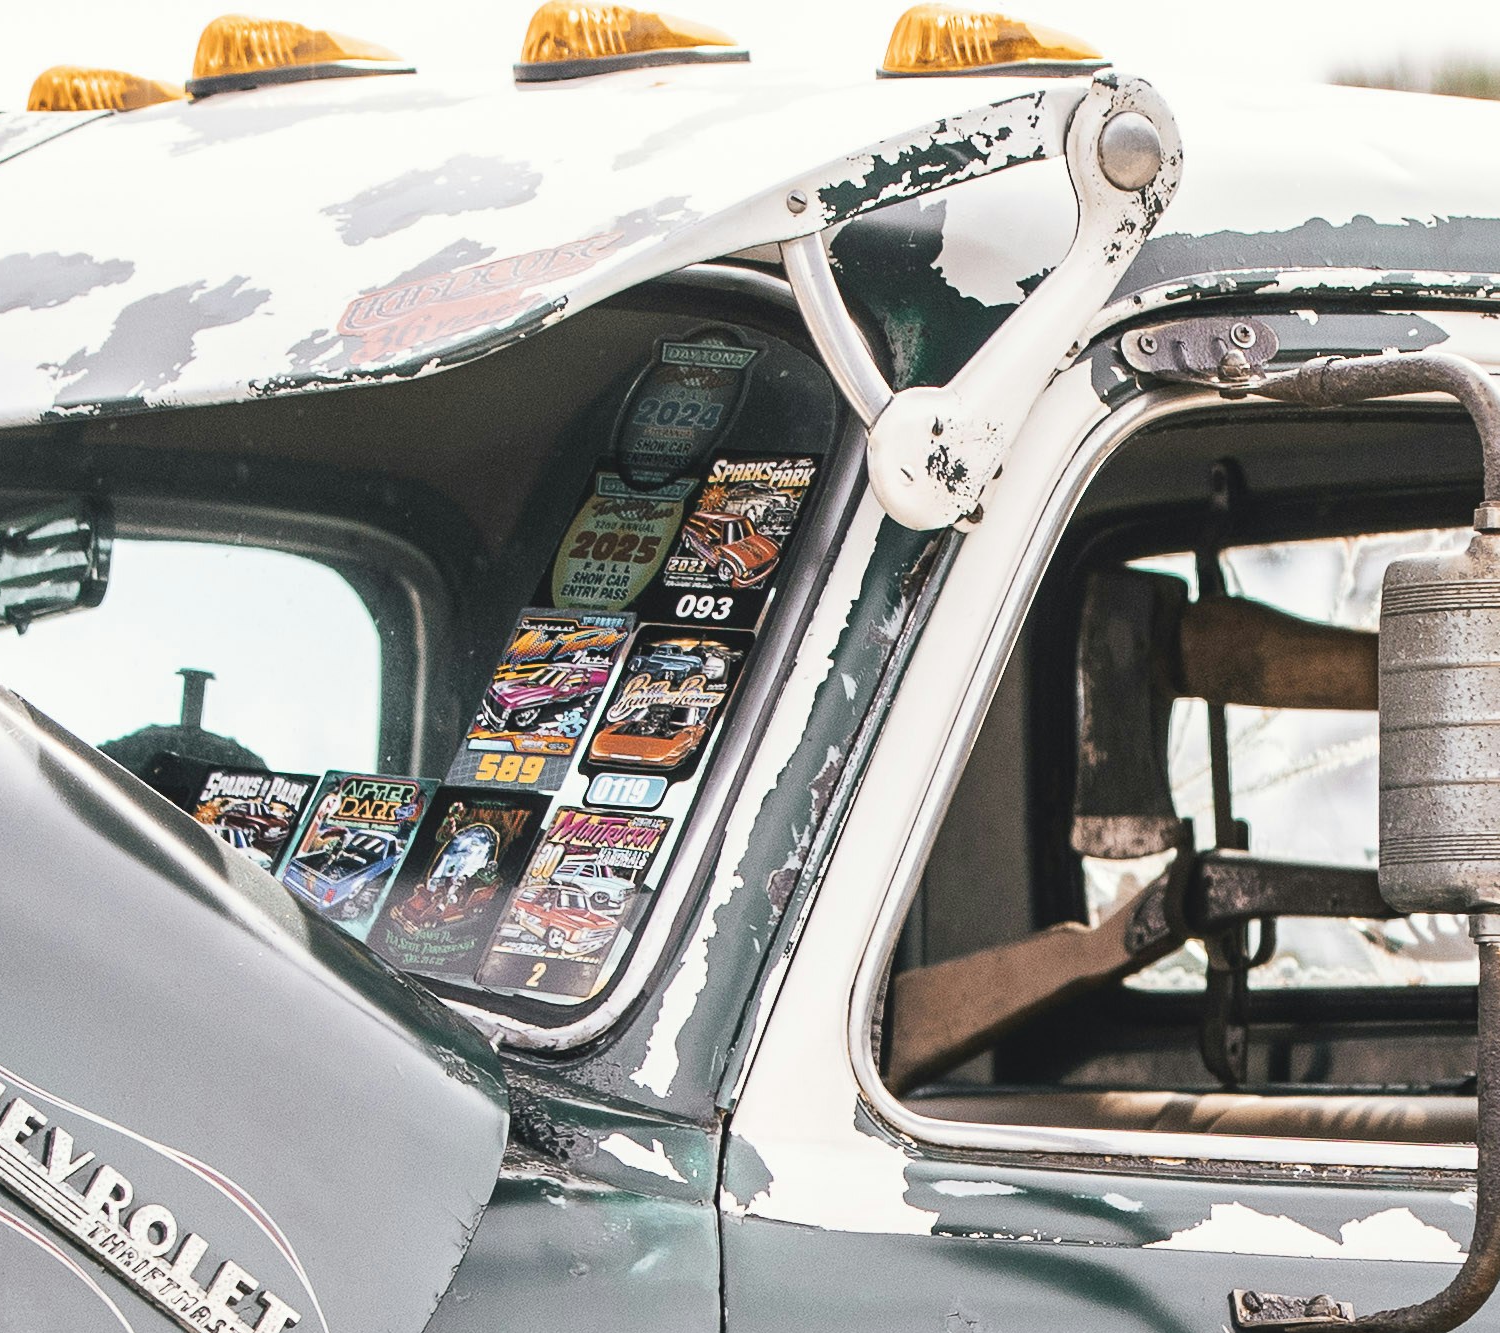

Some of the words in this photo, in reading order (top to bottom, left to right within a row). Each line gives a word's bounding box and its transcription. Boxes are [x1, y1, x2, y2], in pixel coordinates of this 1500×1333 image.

[668, 347, 745, 364] DAYTONA
[633, 397, 724, 431] 2024
[635, 439, 667, 453] SHOW
[668, 441, 692, 455] CAR
[707, 459, 777, 483] SPARKS
[768, 467, 817, 488] PARK
[569, 530, 662, 565] 2025
[571, 572, 606, 585] SHOW
[606, 574, 631, 587] CAR
[560, 585, 598, 599] ENTRY
[600, 587, 629, 601] PASS
[675, 594, 734, 620] 093
[474, 753, 546, 784] 589
[341, 780, 416, 803] AFTER
[593, 776, 650, 803] 0119
[338, 797, 402, 821] DARK
[531, 842, 565, 878] 30
[526, 962, 547, 987] 2
